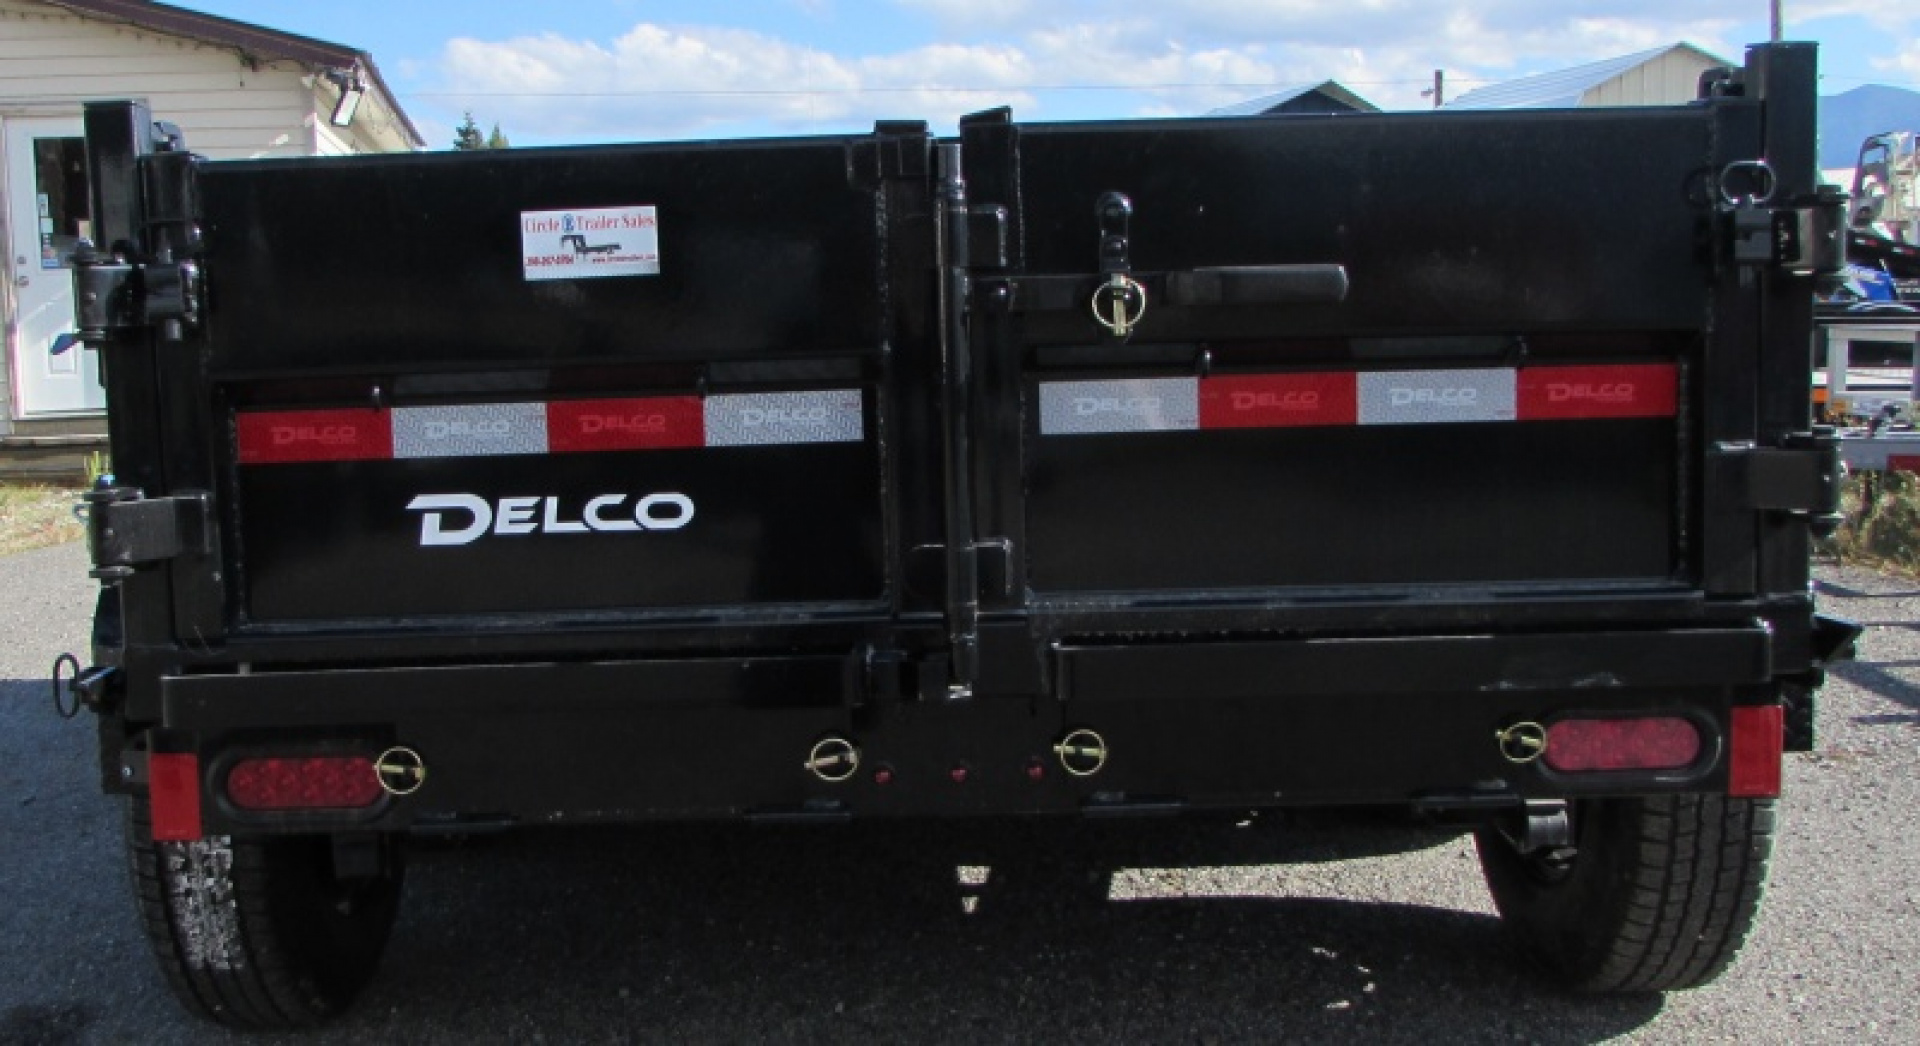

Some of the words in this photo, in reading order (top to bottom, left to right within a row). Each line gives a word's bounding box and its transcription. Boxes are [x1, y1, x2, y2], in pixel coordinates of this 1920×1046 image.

[525, 218, 560, 233] Circle
[576, 215, 620, 231] Trailer
[622, 212, 655, 229] Sales
[1231, 391, 1318, 409] DELCO
[1389, 387, 1477, 406] DELCO
[1546, 383, 1634, 401] DELCO
[1073, 397, 1160, 415] DELCO
[578, 414, 666, 432] DELCO
[740, 408, 828, 426] DELCO
[270, 426, 356, 444] DELCO
[424, 421, 511, 438] DELCO
[405, 492, 695, 546] DELCO
